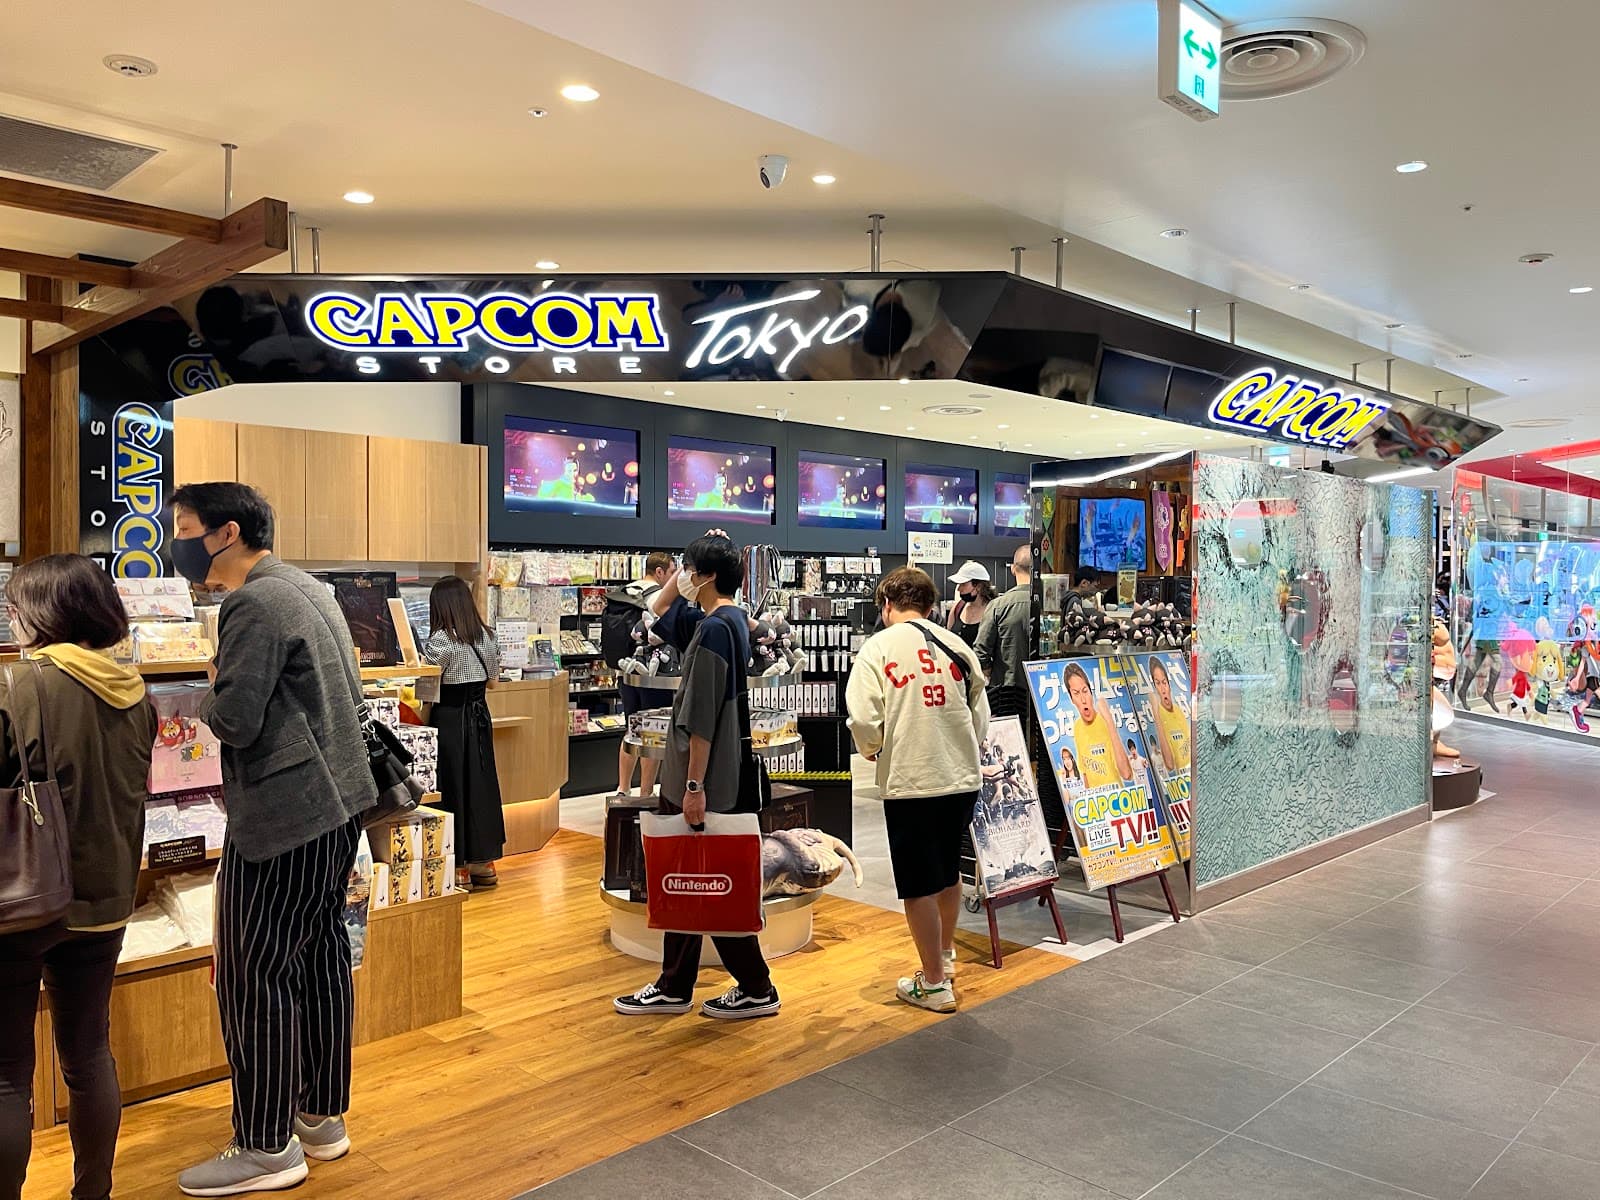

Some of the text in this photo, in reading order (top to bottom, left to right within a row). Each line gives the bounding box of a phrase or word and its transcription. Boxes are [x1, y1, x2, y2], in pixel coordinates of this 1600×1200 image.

[304, 293, 669, 352] CAPCOM
[356, 356, 643, 374] STORE
[1208, 367, 1392, 448] CAPCOM
[90, 420, 107, 571] STO
[112, 402, 164, 578] CAPCO
[922, 684, 946, 707] 93
[1073, 786, 1148, 826] CAPCOM
[1088, 828, 1111, 842] LIVE
[1111, 810, 1159, 849] TV!!
[668, 878, 726, 891] Nintendo
